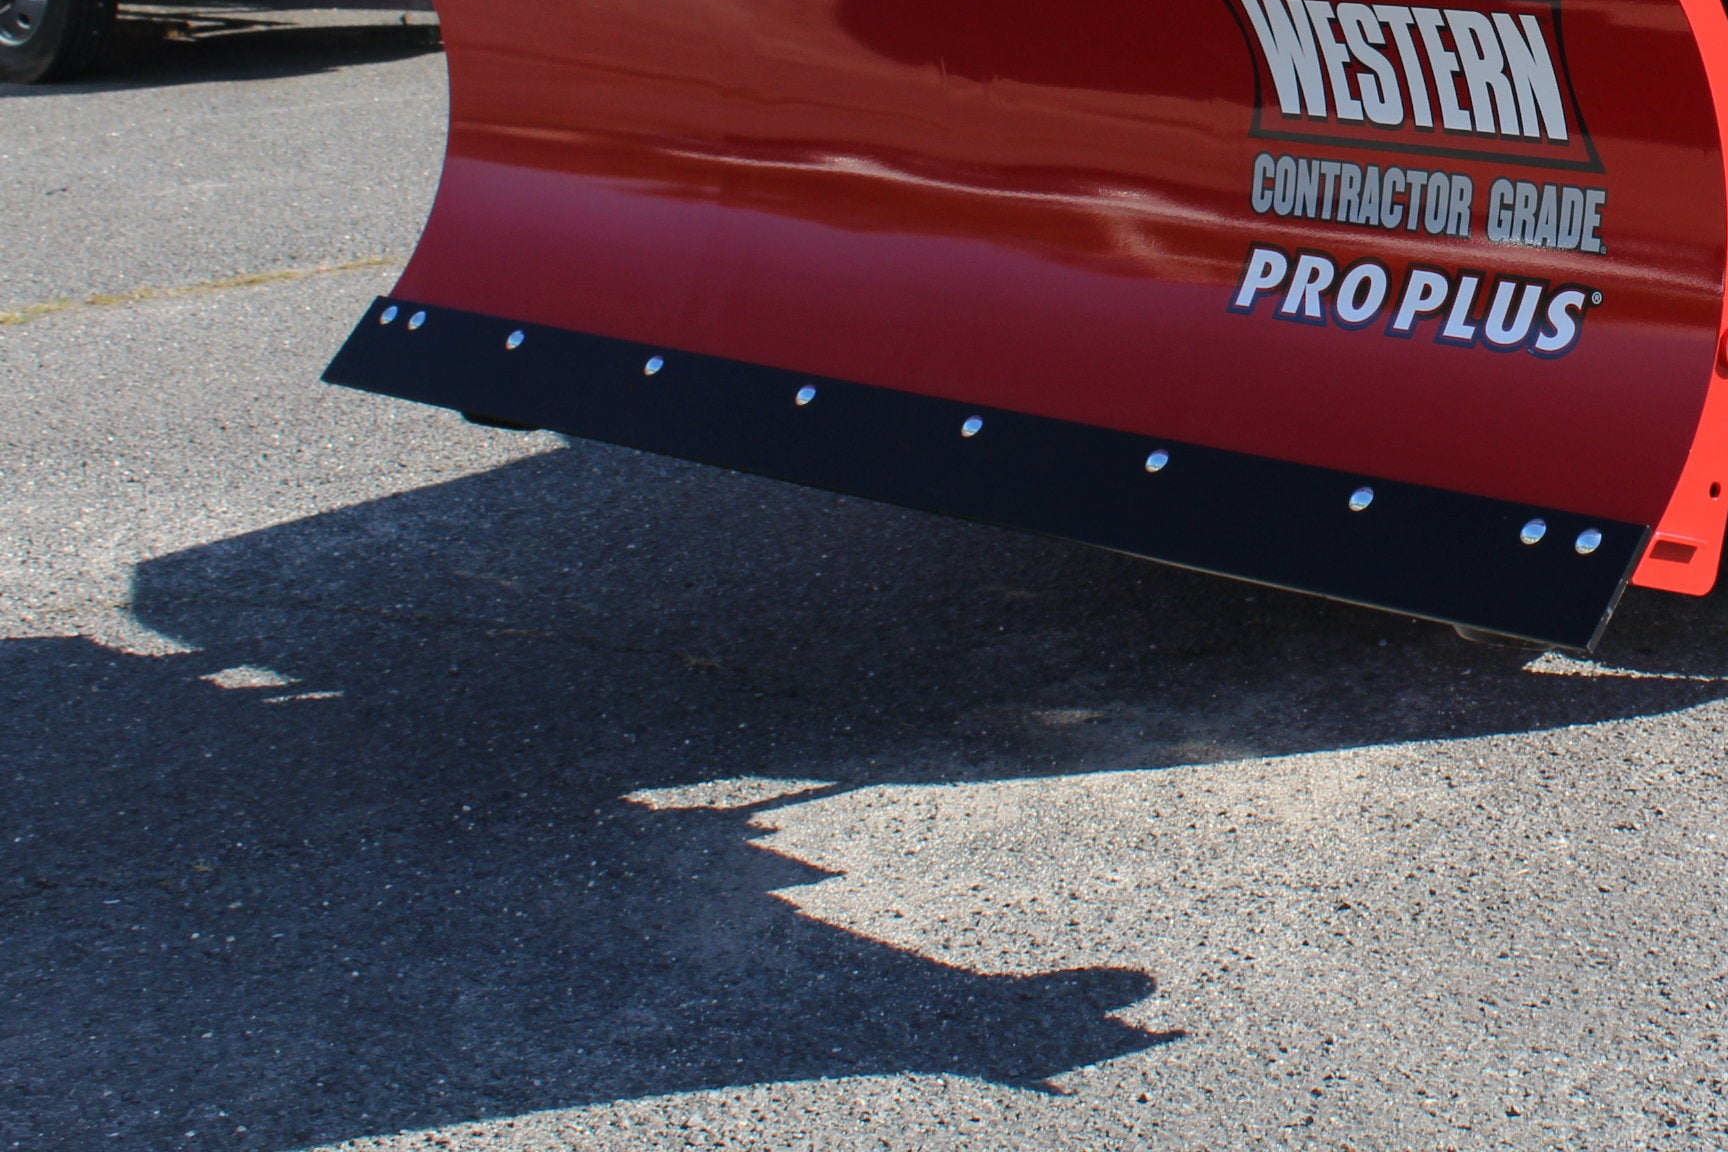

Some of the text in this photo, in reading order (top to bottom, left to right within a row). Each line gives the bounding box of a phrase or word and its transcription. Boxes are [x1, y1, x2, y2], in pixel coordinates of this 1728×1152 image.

[1252, 152, 1605, 253] CONTRACTOR GRADE
[1235, 248, 1387, 323] PRO
